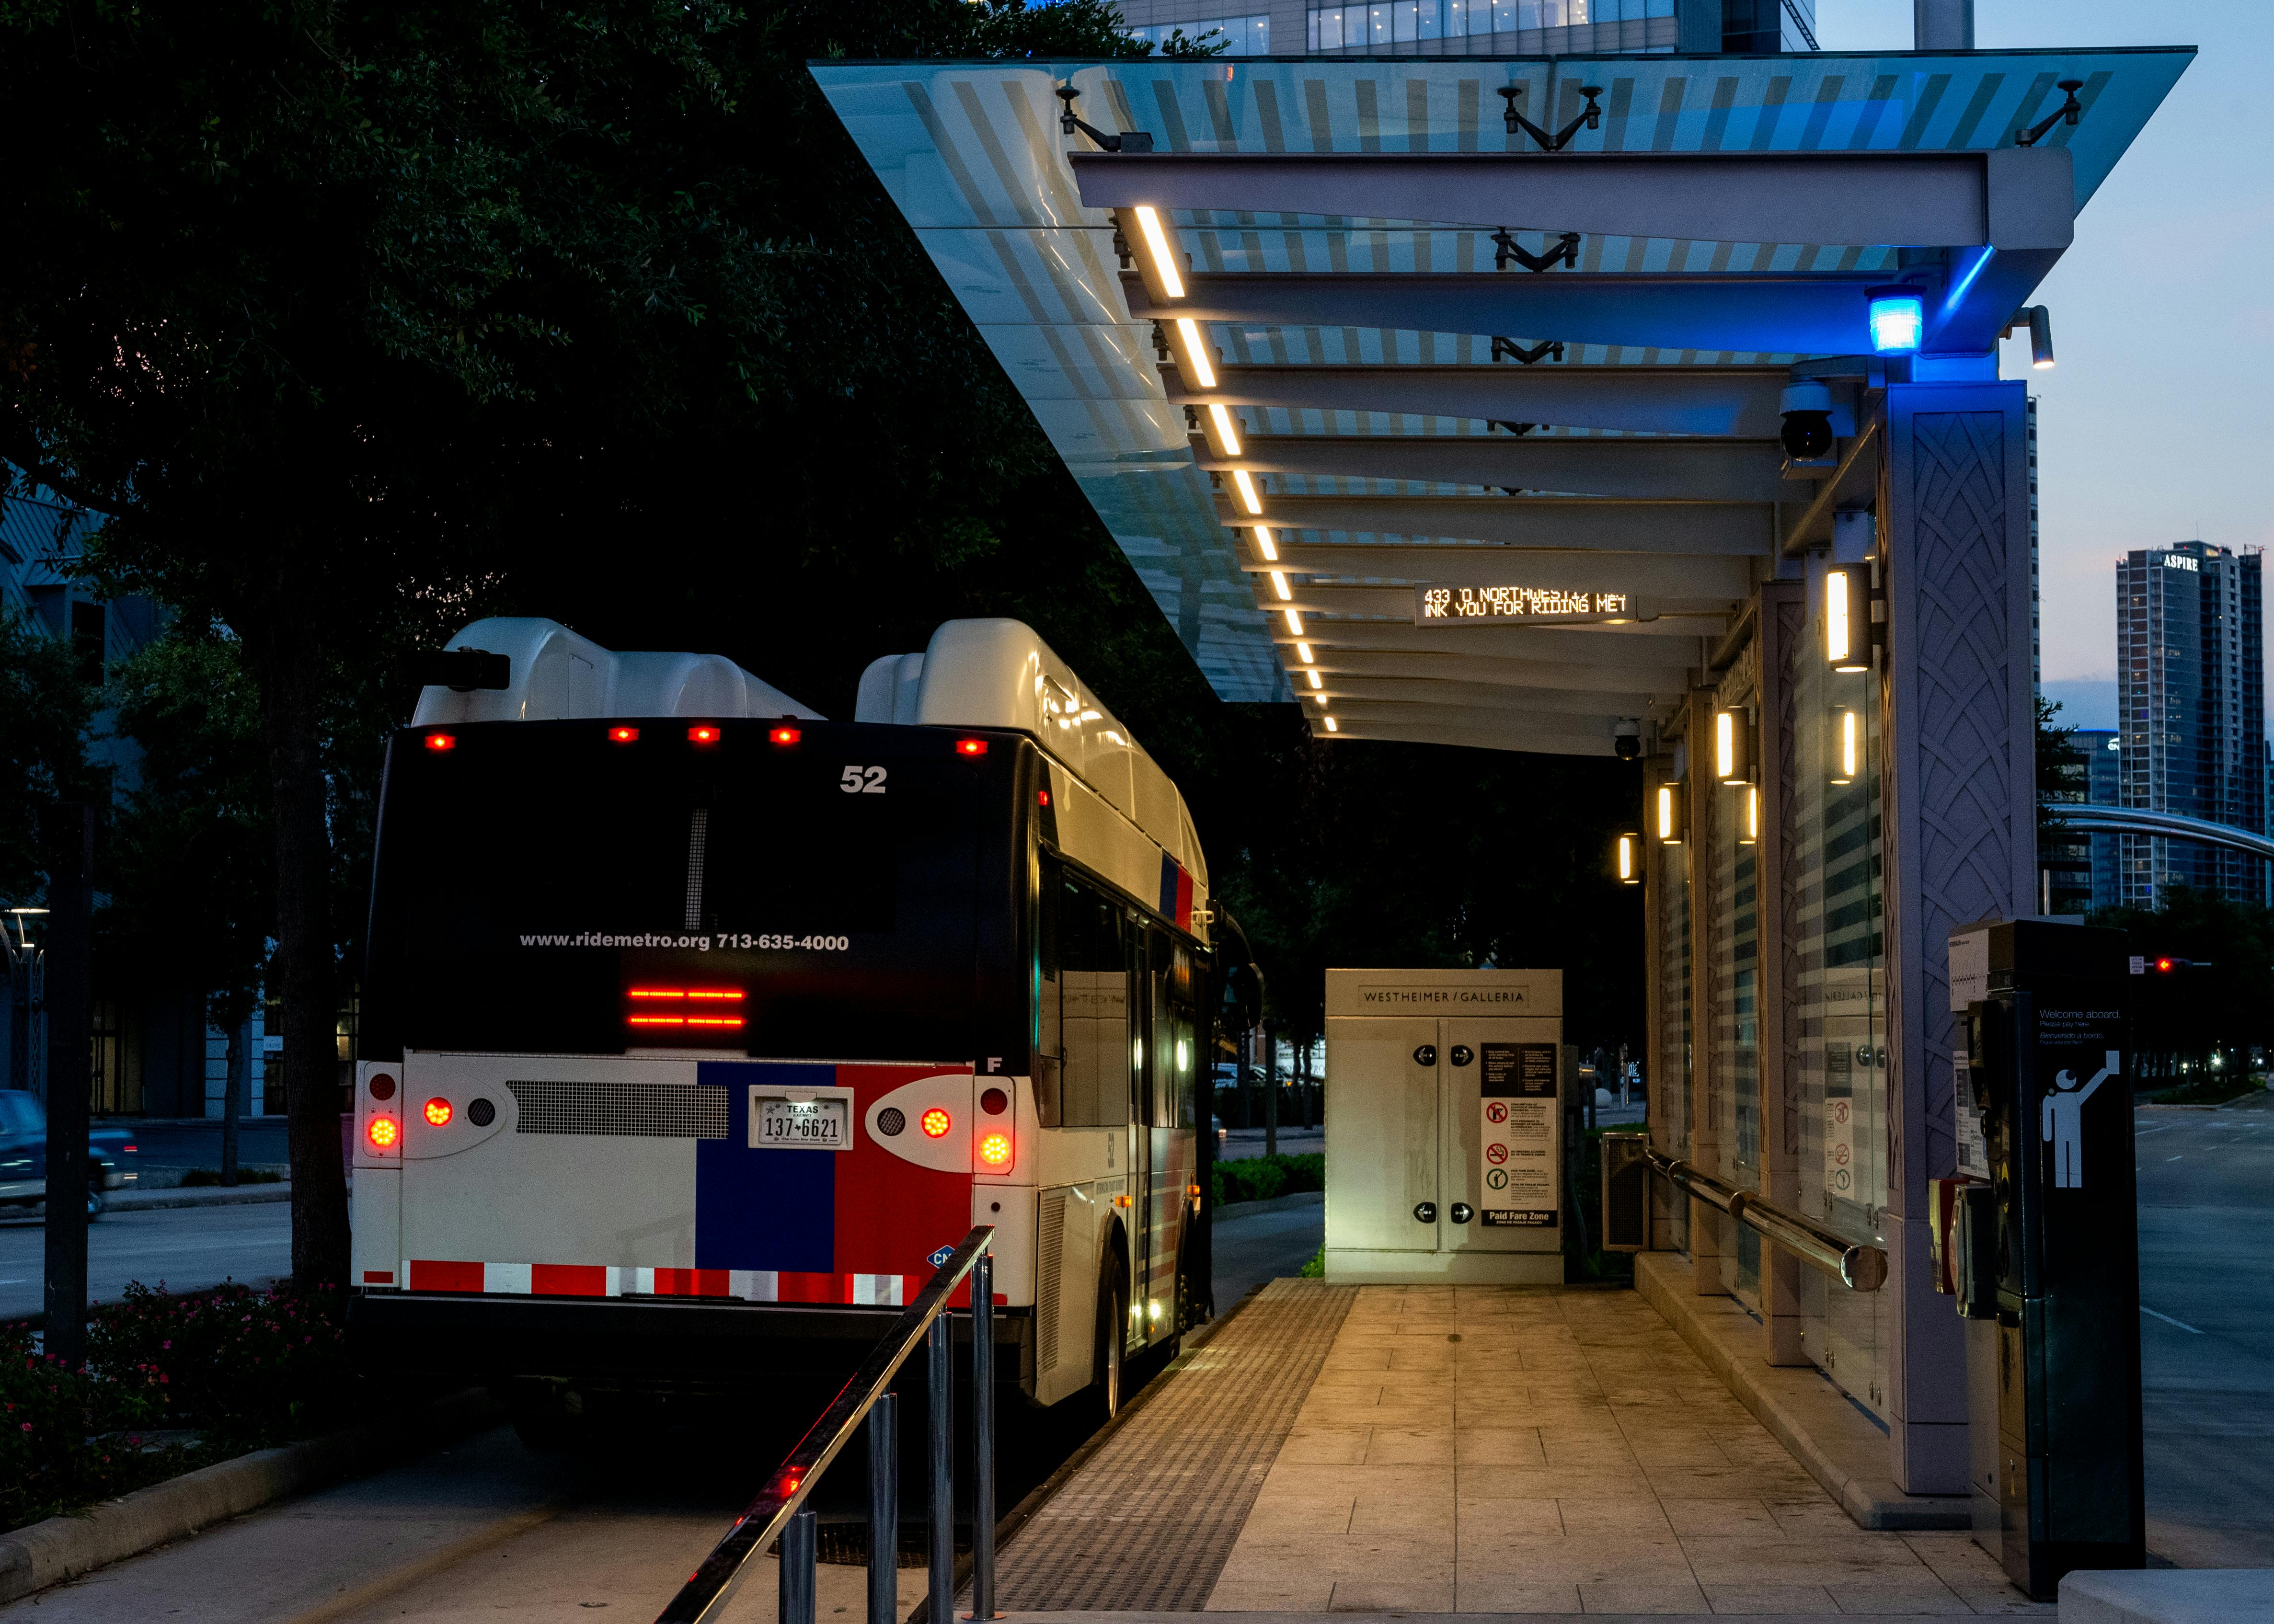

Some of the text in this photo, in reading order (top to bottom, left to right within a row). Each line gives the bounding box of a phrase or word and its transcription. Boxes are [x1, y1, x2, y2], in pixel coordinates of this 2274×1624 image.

[2163, 554, 2198, 572] ASPIRE
[1425, 589, 1450, 603] 433
[1459, 588, 1472, 602] O
[1455, 602, 1486, 617] YOU
[1494, 600, 1524, 616] FOR
[1531, 598, 1589, 614] RIDING
[1596, 597, 1626, 612] MET
[840, 766, 887, 793] 52
[520, 932, 849, 951] www.ridemetro.org 713-635-4000
[1364, 992, 1449, 1002] WESTHEIMER
[1460, 992, 1524, 1002] GALLERIA
[2039, 1009, 2121, 1019] Welcome aboard.
[988, 1057, 1002, 1072] F
[787, 1105, 818, 1113] TEXAS
[1489, 1212, 1549, 1220] Paid Fare Zone
